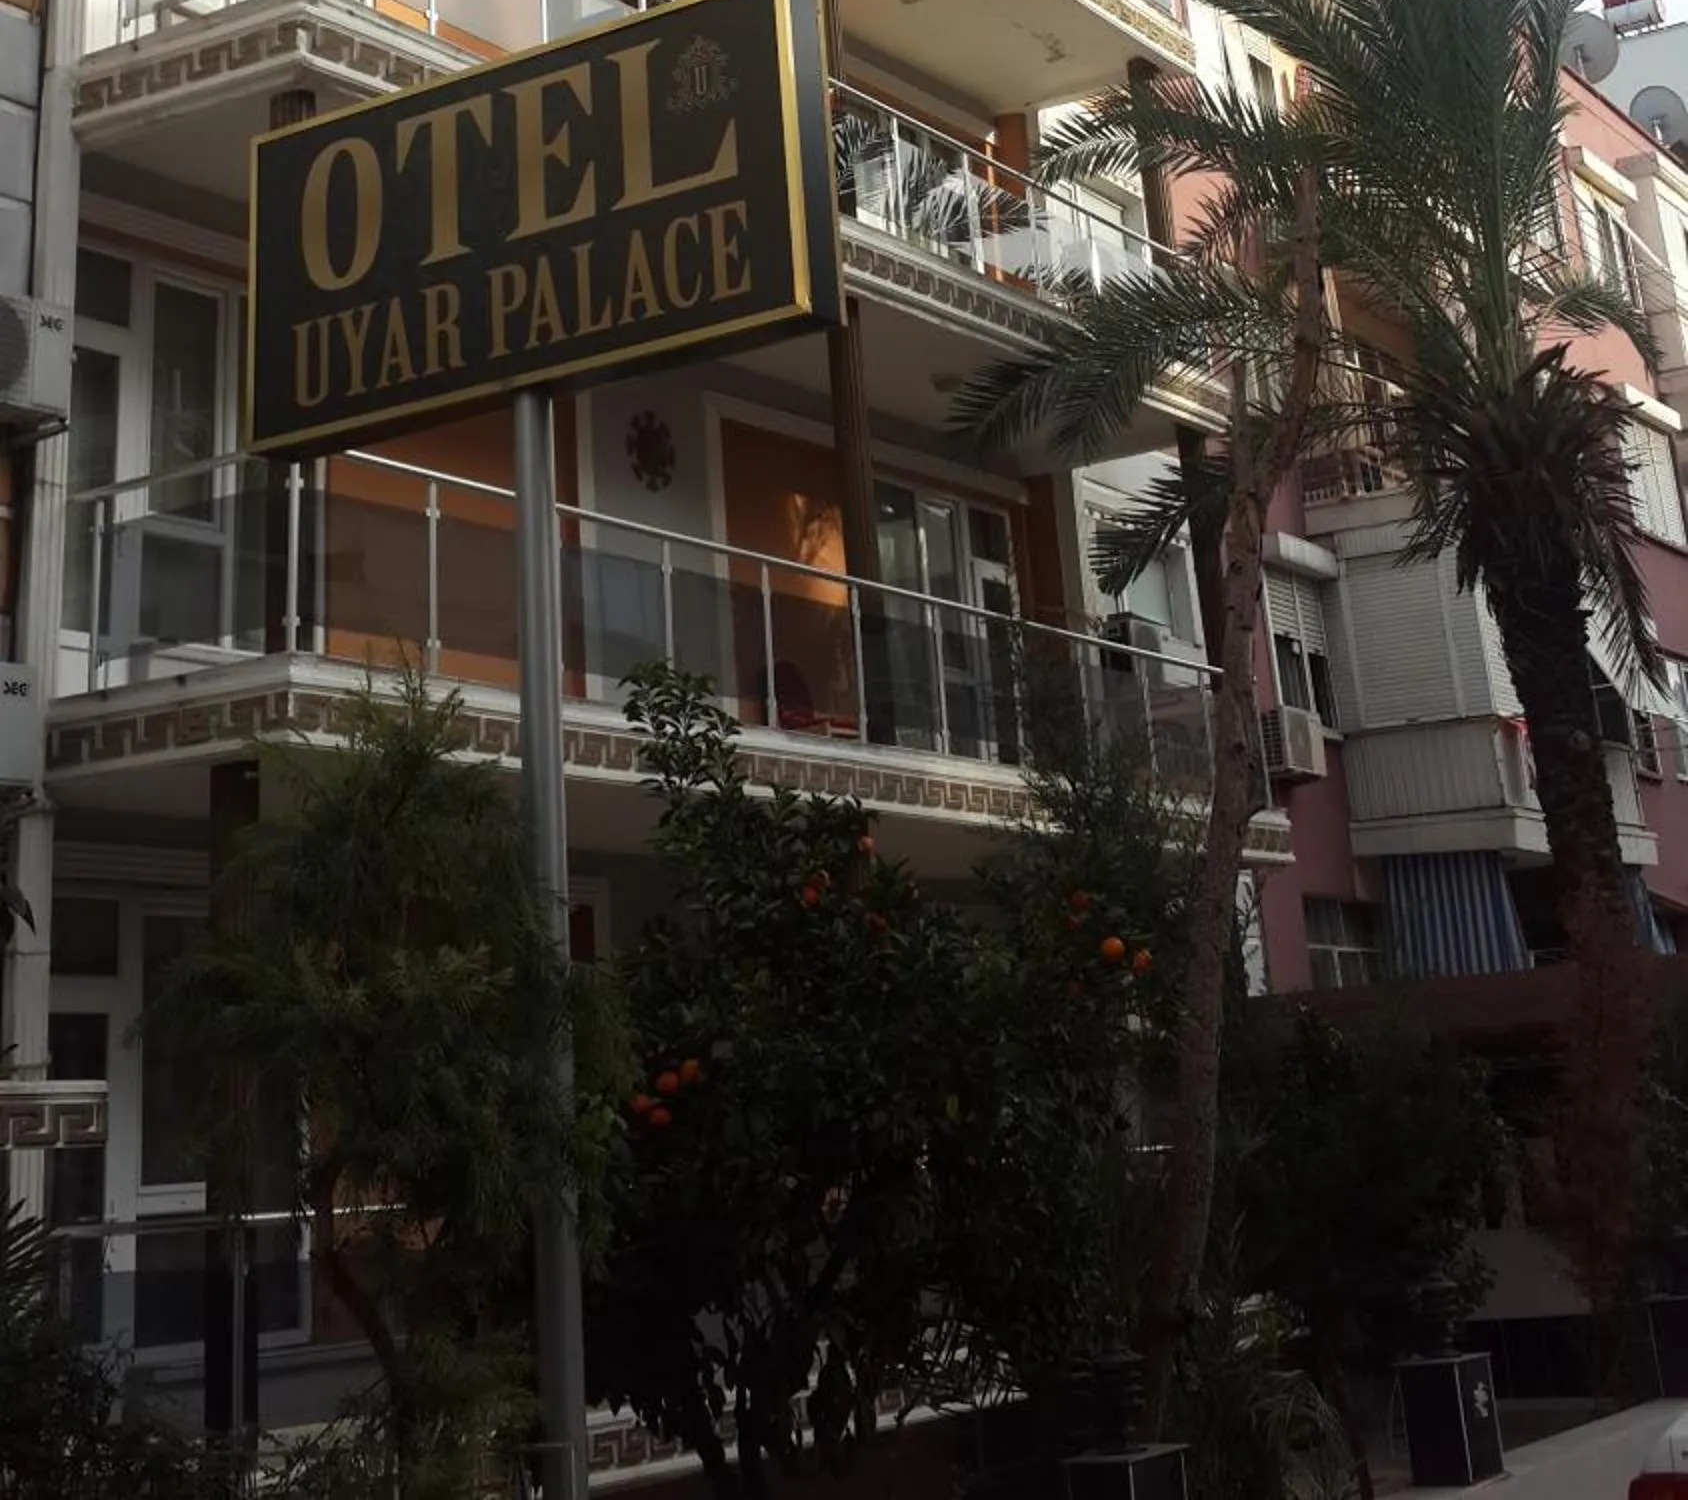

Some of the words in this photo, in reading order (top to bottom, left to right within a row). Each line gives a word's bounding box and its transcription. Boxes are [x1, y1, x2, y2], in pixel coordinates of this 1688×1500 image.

[300, 37, 739, 292] OTEL
[293, 280, 468, 408] UYAR
[486, 199, 753, 360] PALACE
